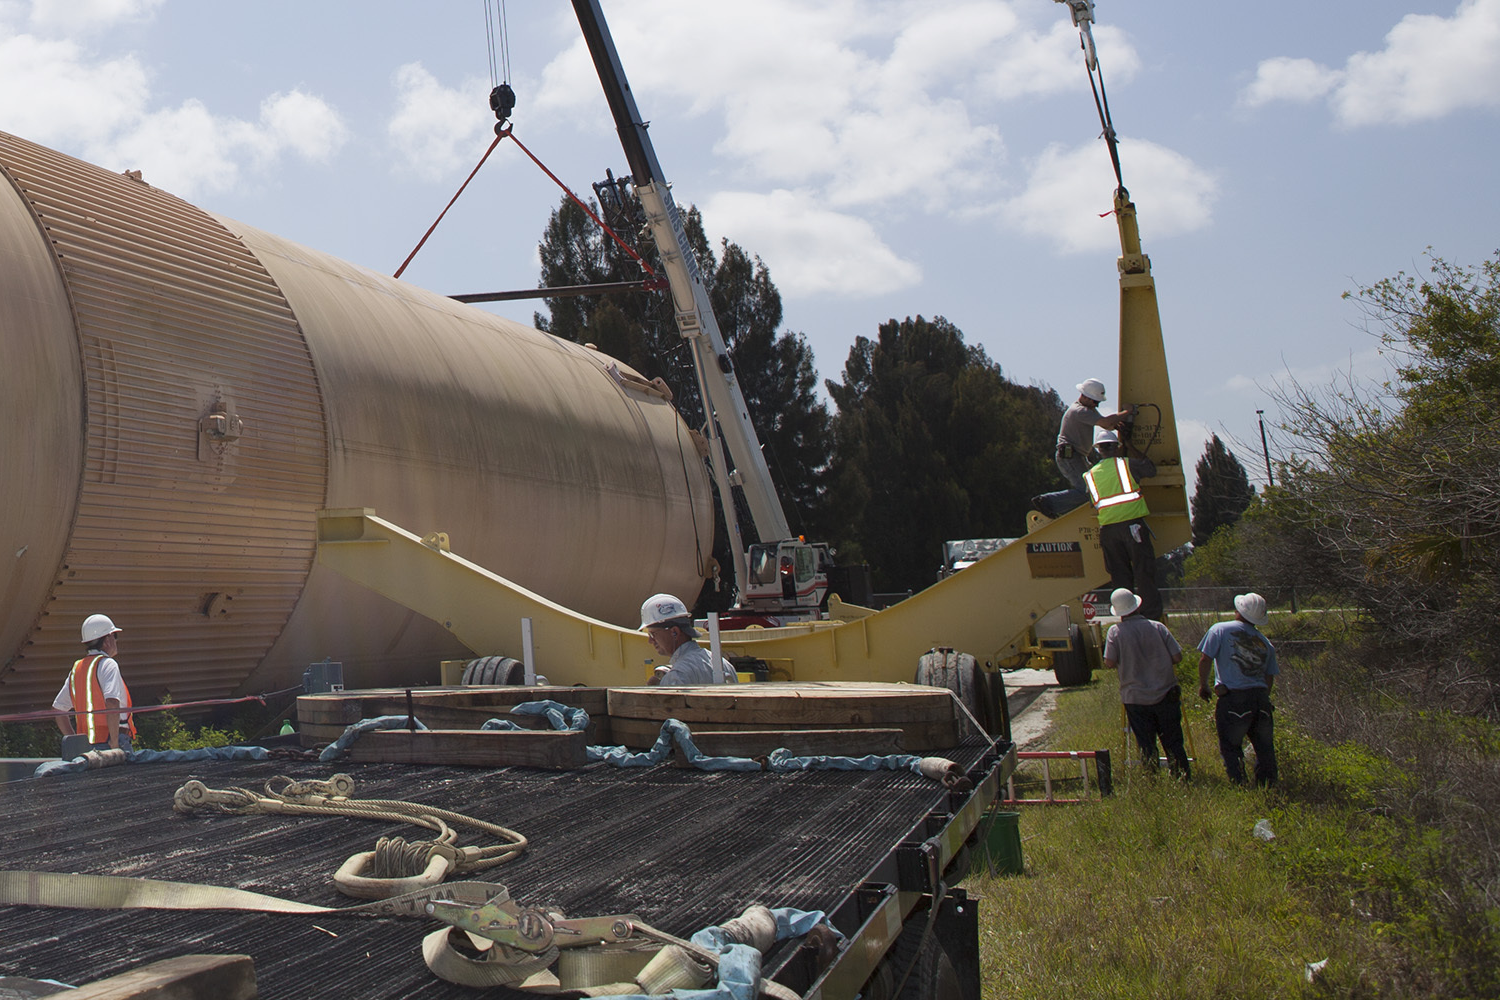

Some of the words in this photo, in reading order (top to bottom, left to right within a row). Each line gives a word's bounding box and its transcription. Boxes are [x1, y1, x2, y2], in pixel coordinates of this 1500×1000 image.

[663, 193, 682, 233] SIMS
[676, 231, 700, 282] CRANE
[1032, 543, 1073, 552] CAUTION
[1083, 607, 1095, 615] TOP
